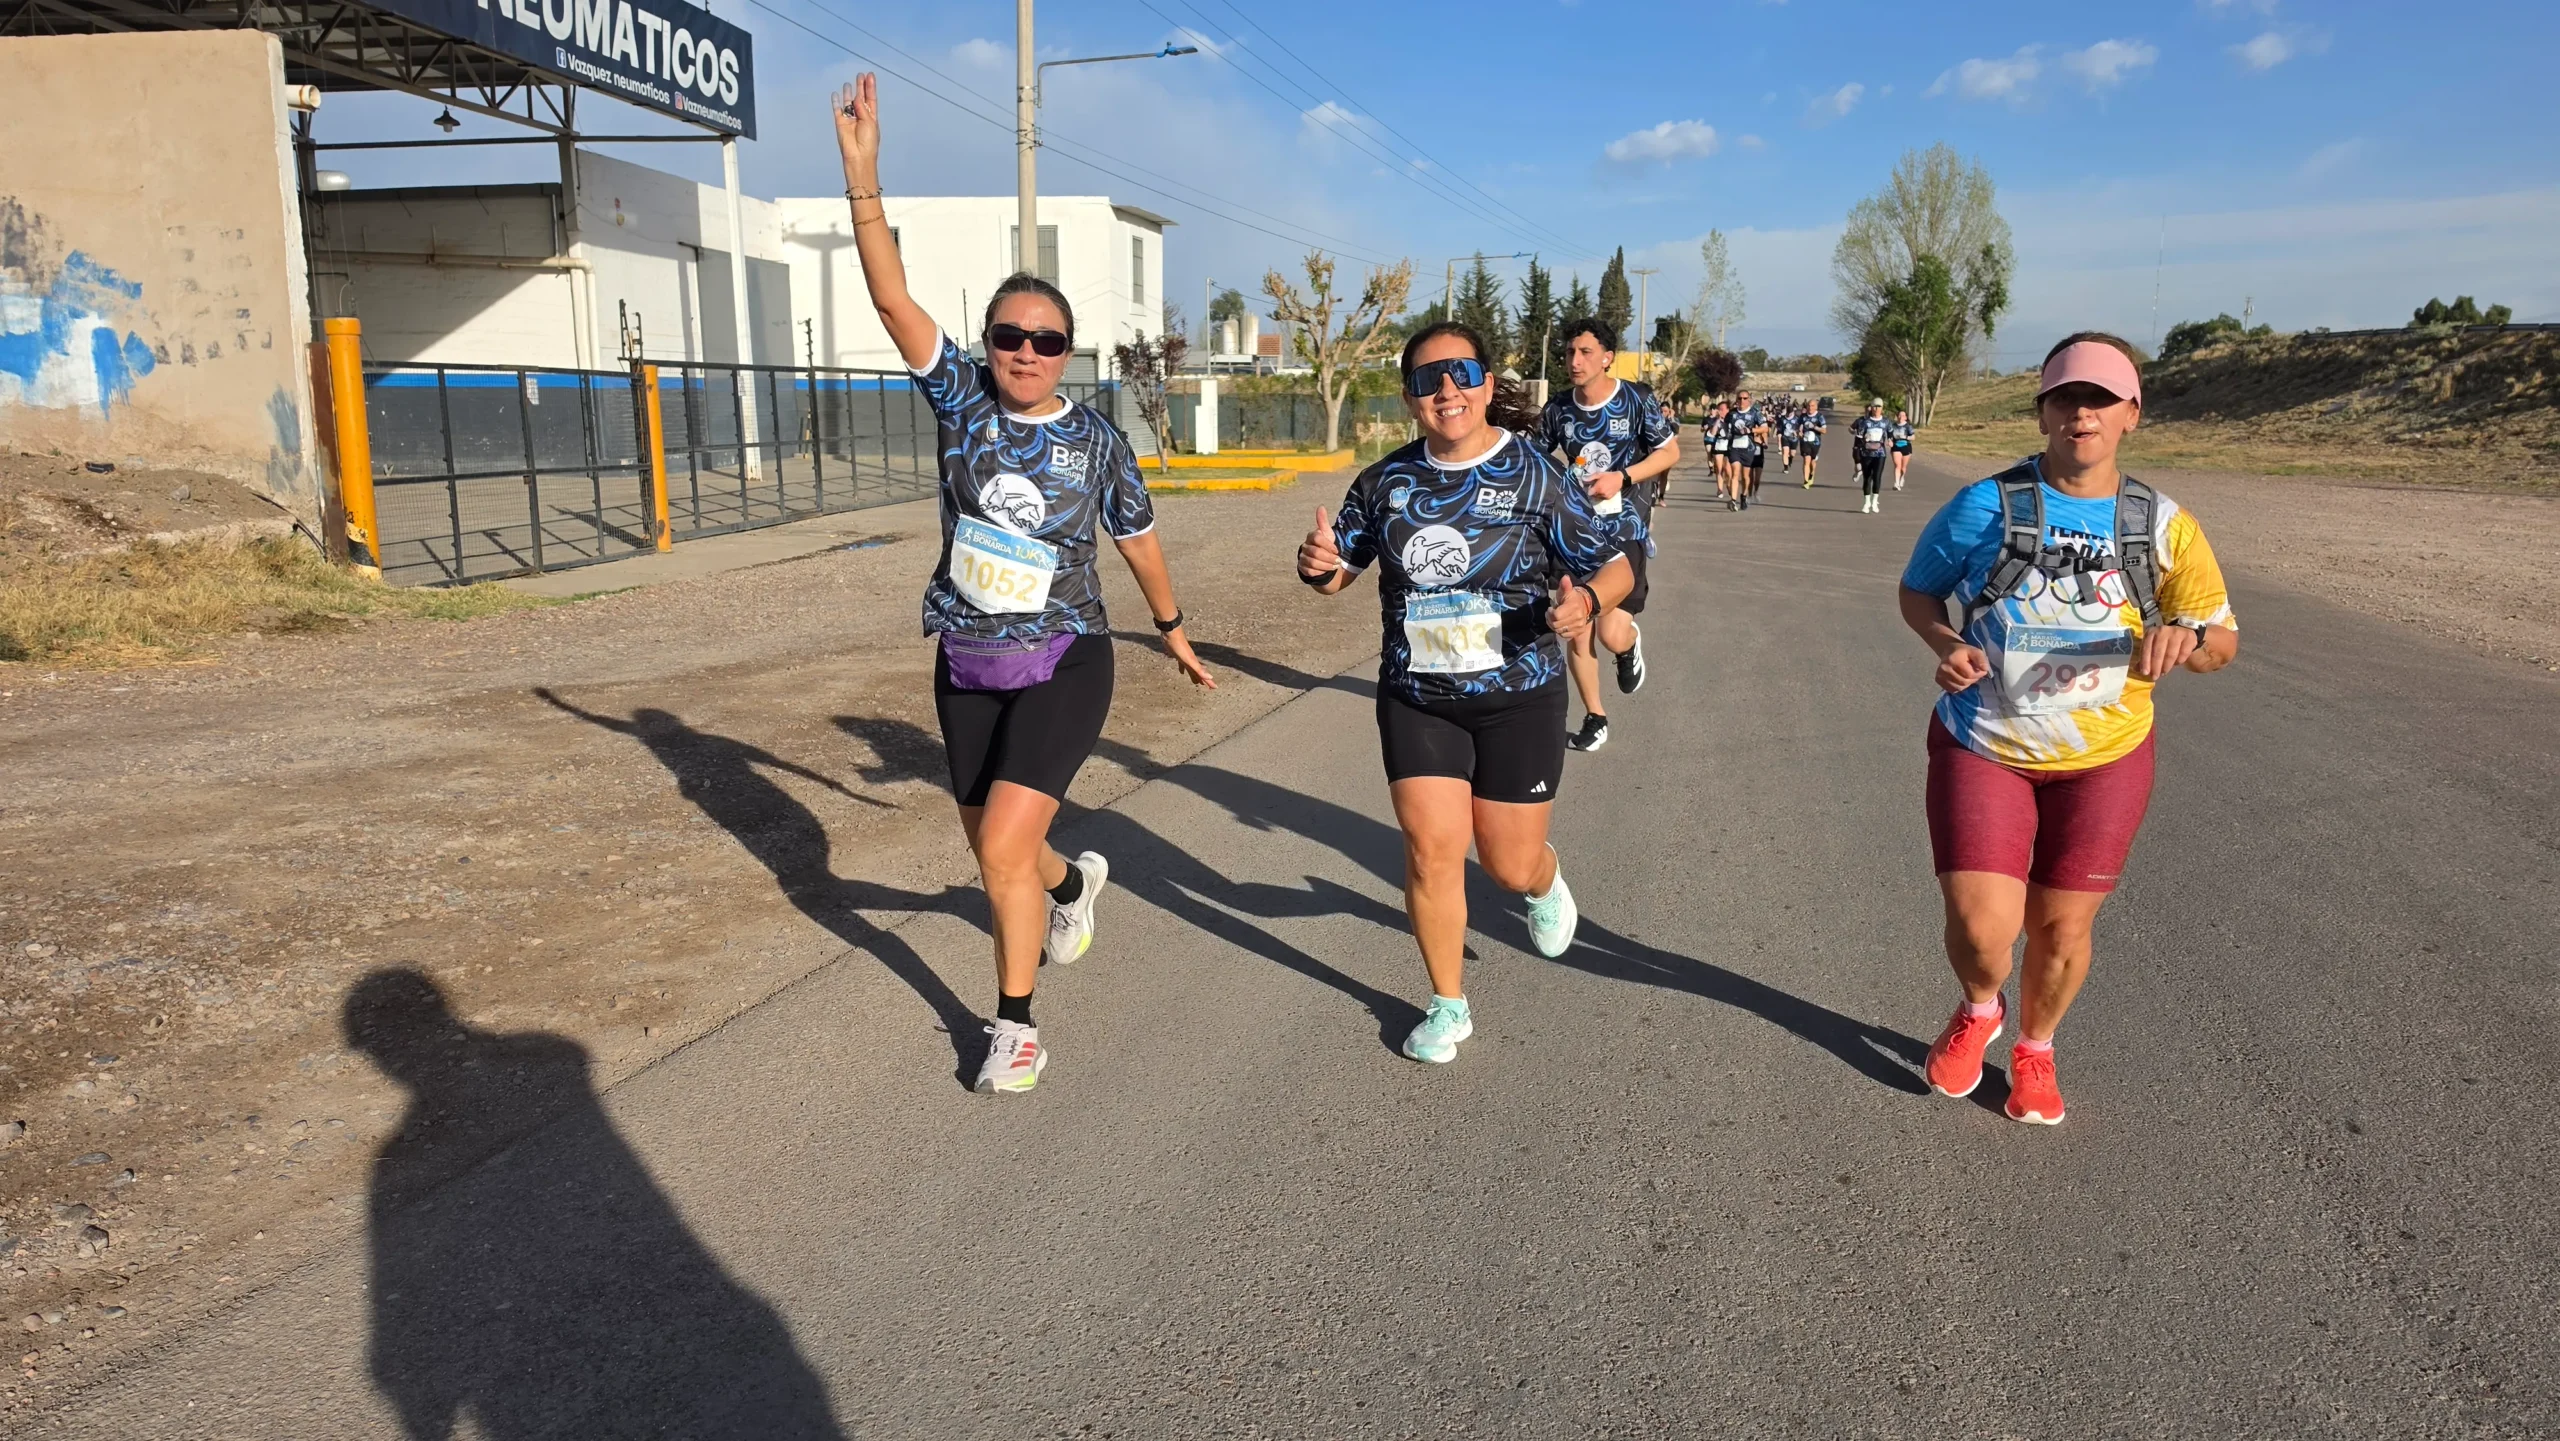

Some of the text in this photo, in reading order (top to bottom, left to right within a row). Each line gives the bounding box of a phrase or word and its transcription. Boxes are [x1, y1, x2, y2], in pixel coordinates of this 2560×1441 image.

[477, 0, 739, 105] UMATICOS
[567, 53, 612, 82] Vazquez
[614, 73, 670, 104] neumaticos
[682, 95, 742, 130] Vazneumaticos
[973, 534, 1012, 554] BONARDA
[963, 554, 1038, 603] 1052
[1424, 606, 1460, 616] BONARDA
[2030, 640, 2081, 650] BONARDA
[2028, 662, 2100, 694] 293
